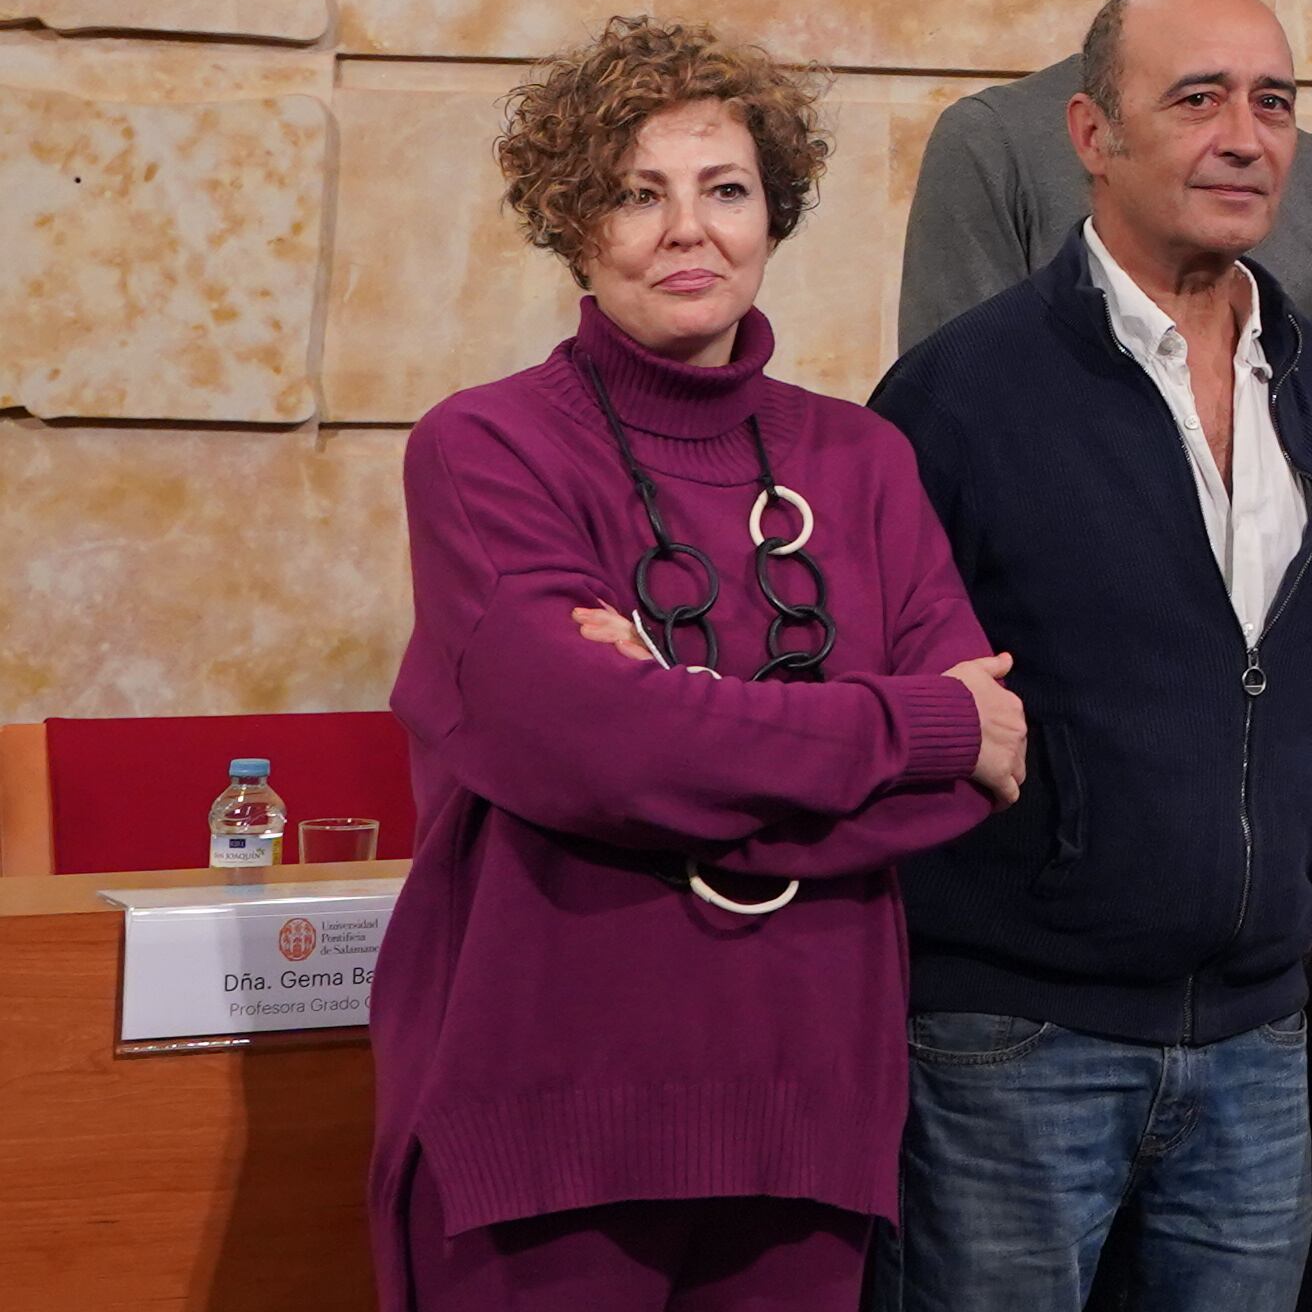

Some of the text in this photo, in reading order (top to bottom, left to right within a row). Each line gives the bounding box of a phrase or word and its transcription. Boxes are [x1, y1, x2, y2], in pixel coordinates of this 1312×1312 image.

[321, 918, 379, 930] Universidad
[321, 932, 366, 943] Pontificia
[320, 946, 330, 956] de
[224, 973, 272, 992] Dña.
[280, 970, 343, 989] Gema
[229, 1000, 305, 1017] Profesora
[310, 996, 360, 1012] Grado
